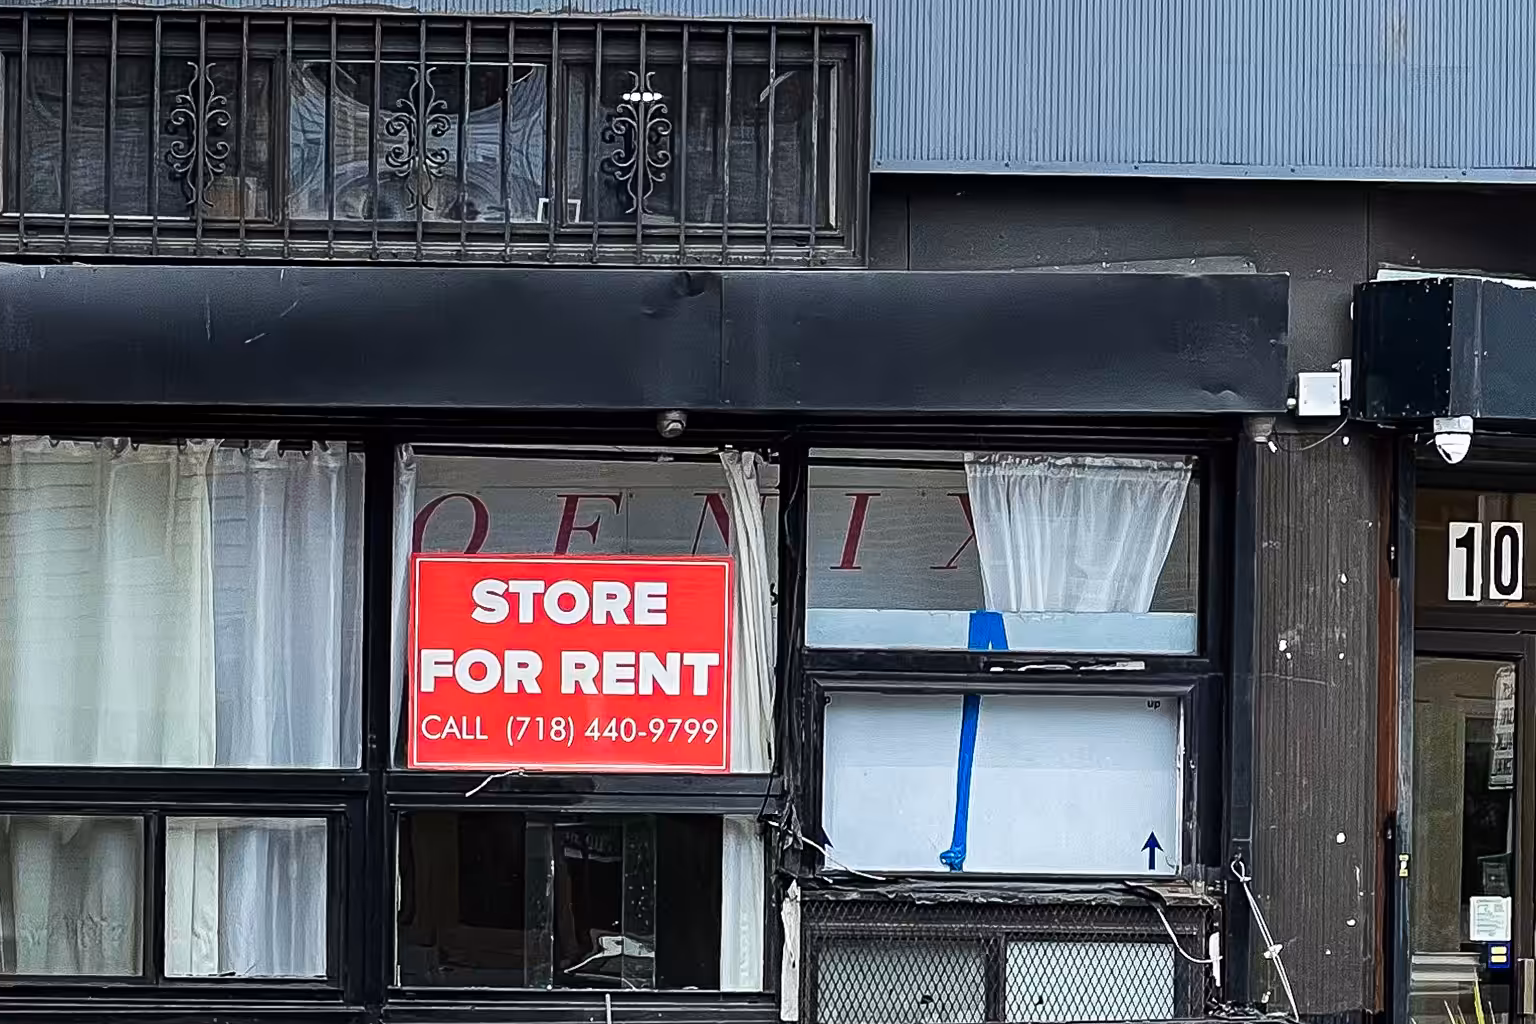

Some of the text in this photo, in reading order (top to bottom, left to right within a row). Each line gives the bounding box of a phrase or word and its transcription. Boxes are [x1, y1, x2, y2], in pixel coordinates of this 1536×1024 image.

[1455, 525, 1519, 597] 10
[471, 579, 668, 625] STORE
[420, 649, 720, 696] FOR RENT
[421, 714, 719, 747] CALL (718) 440-9799
